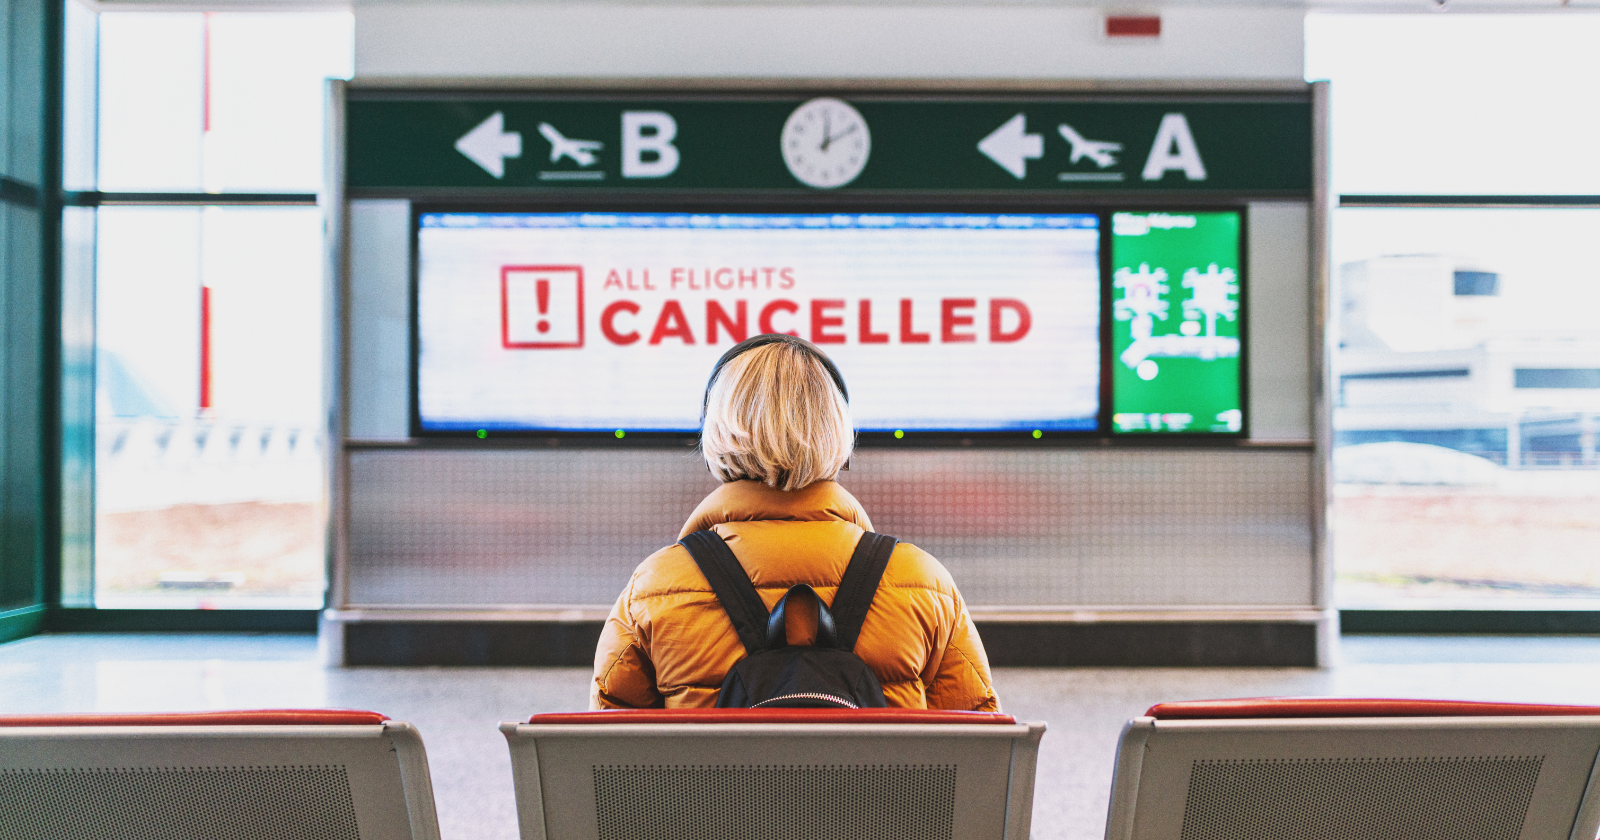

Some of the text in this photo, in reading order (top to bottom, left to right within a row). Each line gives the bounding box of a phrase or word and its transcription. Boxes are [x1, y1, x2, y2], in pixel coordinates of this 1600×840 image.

[621, 111, 680, 178] B
[1142, 112, 1207, 181] A
[603, 267, 796, 291] ALL FLIGHTS
[600, 298, 1034, 347] CANCELLED
